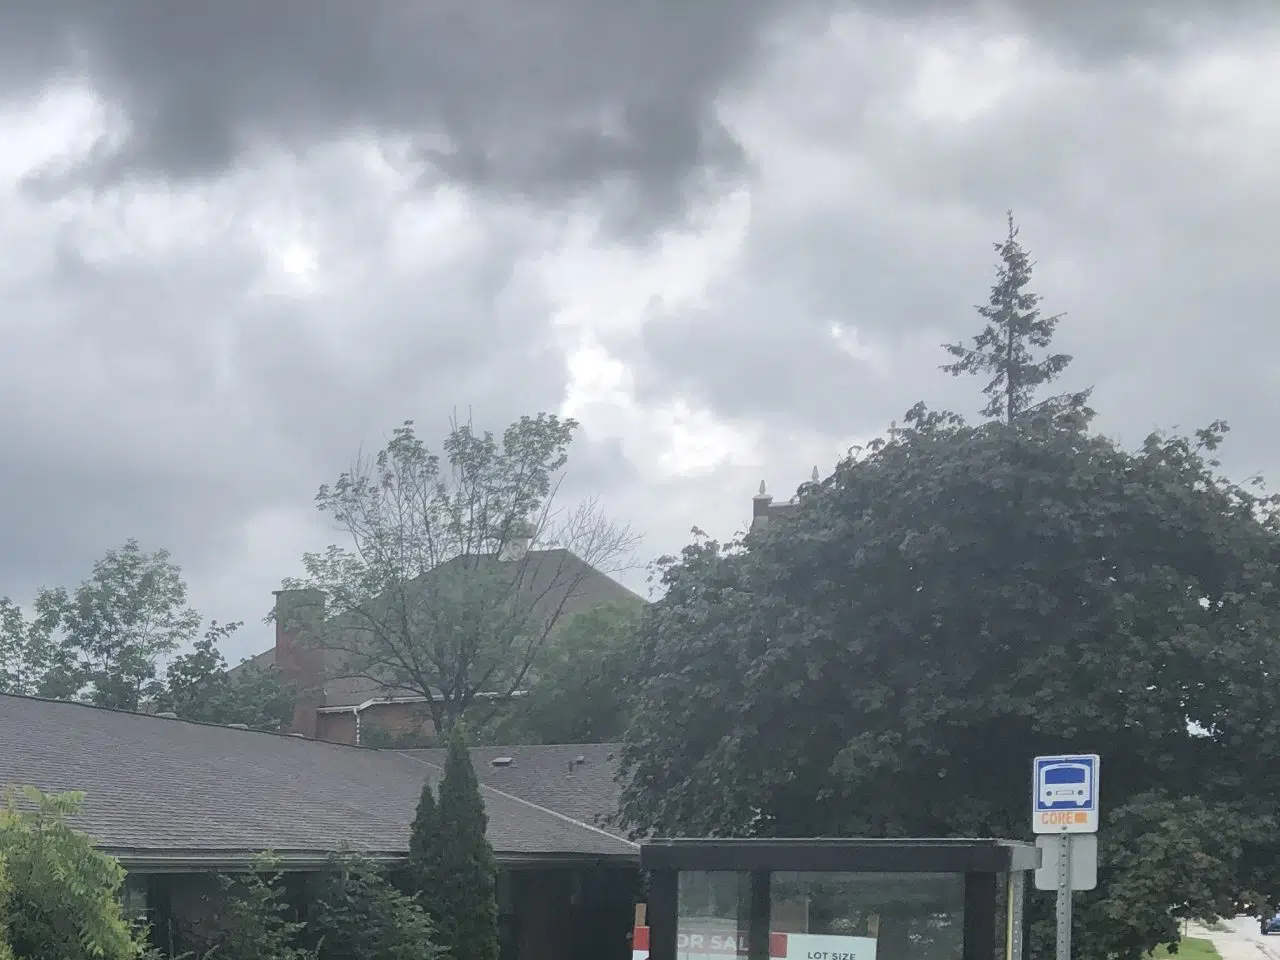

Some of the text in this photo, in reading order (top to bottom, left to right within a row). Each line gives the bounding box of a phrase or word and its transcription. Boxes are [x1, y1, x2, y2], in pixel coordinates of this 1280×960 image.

[1042, 812, 1073, 825] CORE
[677, 935, 749, 952] OR SAL
[807, 951, 829, 960] LOT
